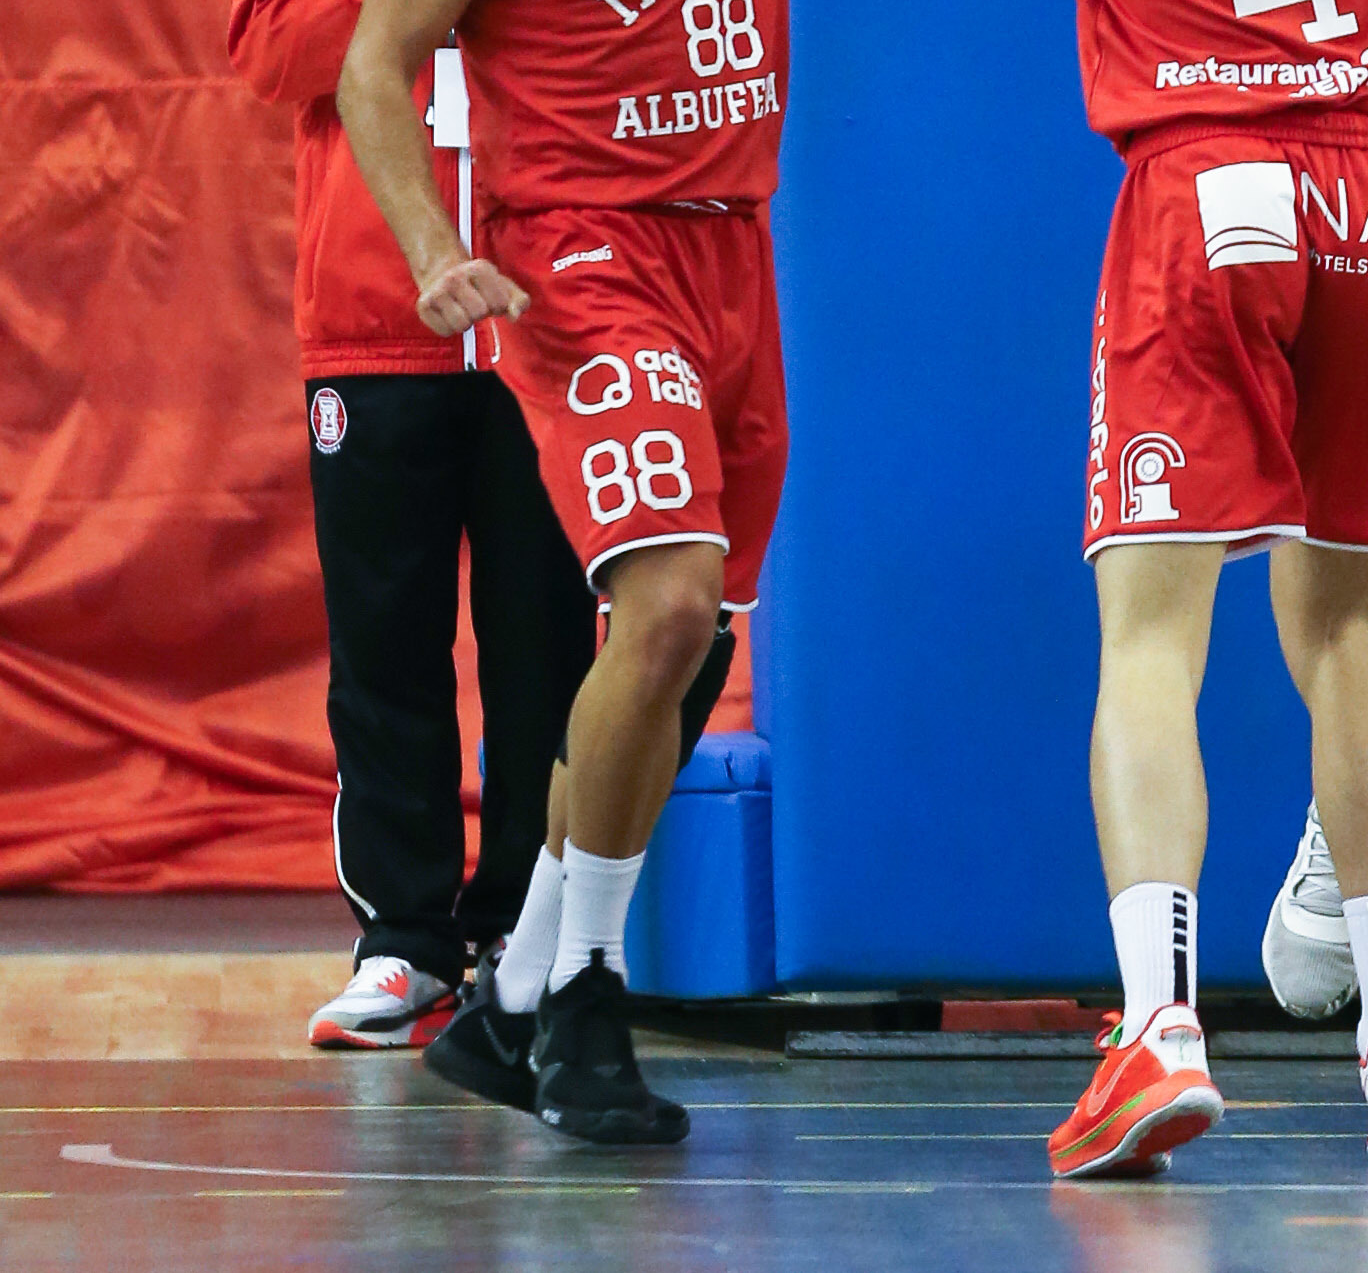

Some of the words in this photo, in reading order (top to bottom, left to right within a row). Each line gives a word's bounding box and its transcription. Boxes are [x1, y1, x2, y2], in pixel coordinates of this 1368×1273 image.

[1156, 56, 1352, 90] Restaurante
[646, 371, 703, 410] lab
[581, 430, 693, 526] 88
